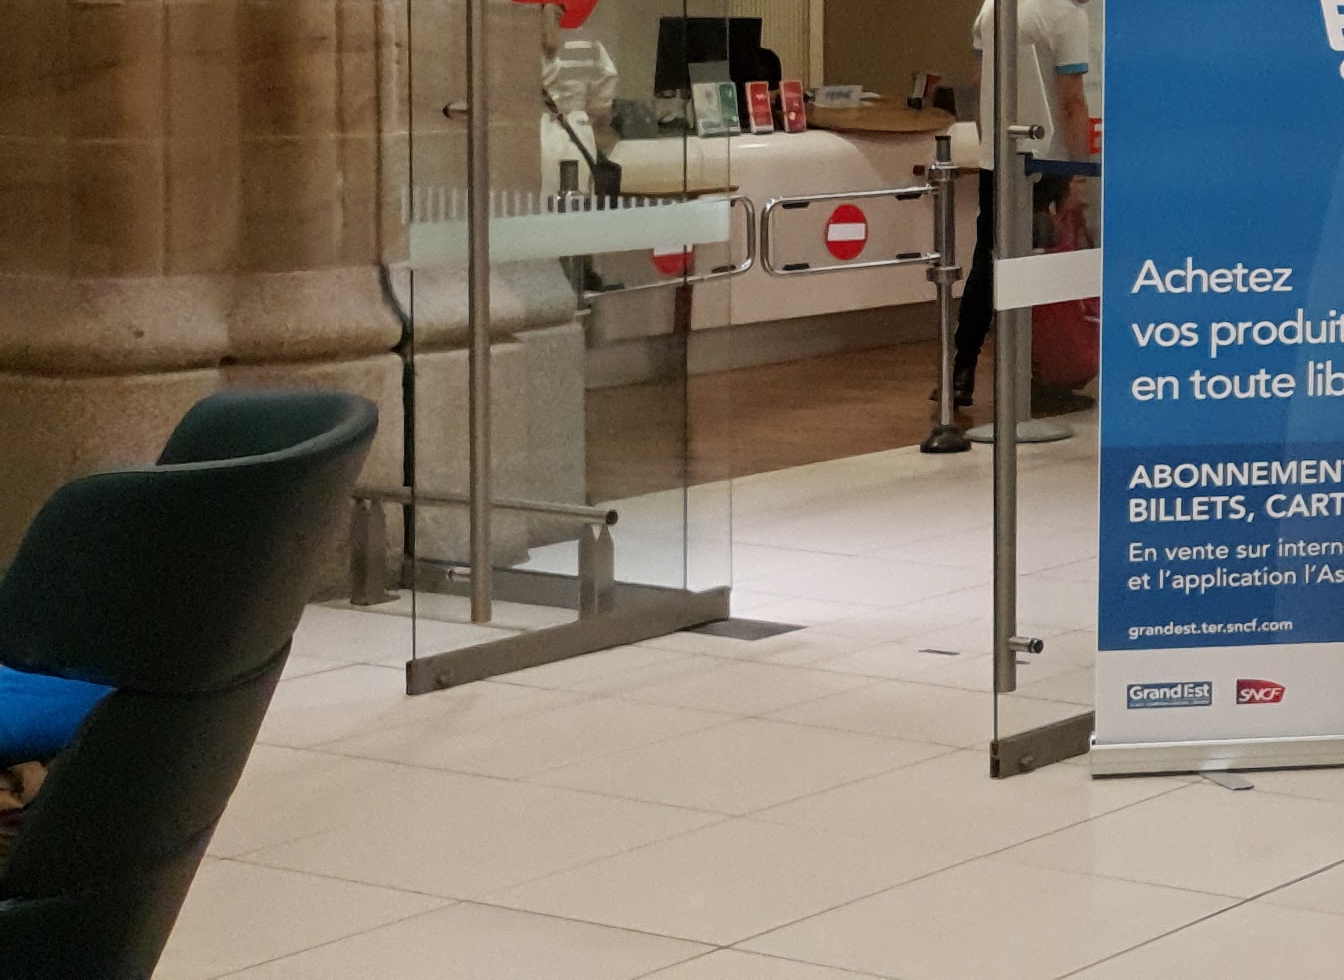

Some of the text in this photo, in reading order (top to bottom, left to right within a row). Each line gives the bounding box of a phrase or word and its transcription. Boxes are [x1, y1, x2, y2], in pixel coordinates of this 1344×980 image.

[1132, 258, 1293, 294] Achetez
[1132, 321, 1199, 347] vos
[1131, 375, 1179, 401] en
[1190, 369, 1296, 399] toute
[1129, 495, 1255, 523] BILLETS,
[1129, 542, 1157, 561] En
[1165, 543, 1229, 561] vente
[1236, 543, 1270, 558] sur
[1128, 574, 1151, 590] et
[1158, 567, 1297, 594] l'application
[1128, 618, 1293, 640] grandest.ter.sncf.com
[1239, 687, 1283, 702] SNCF
